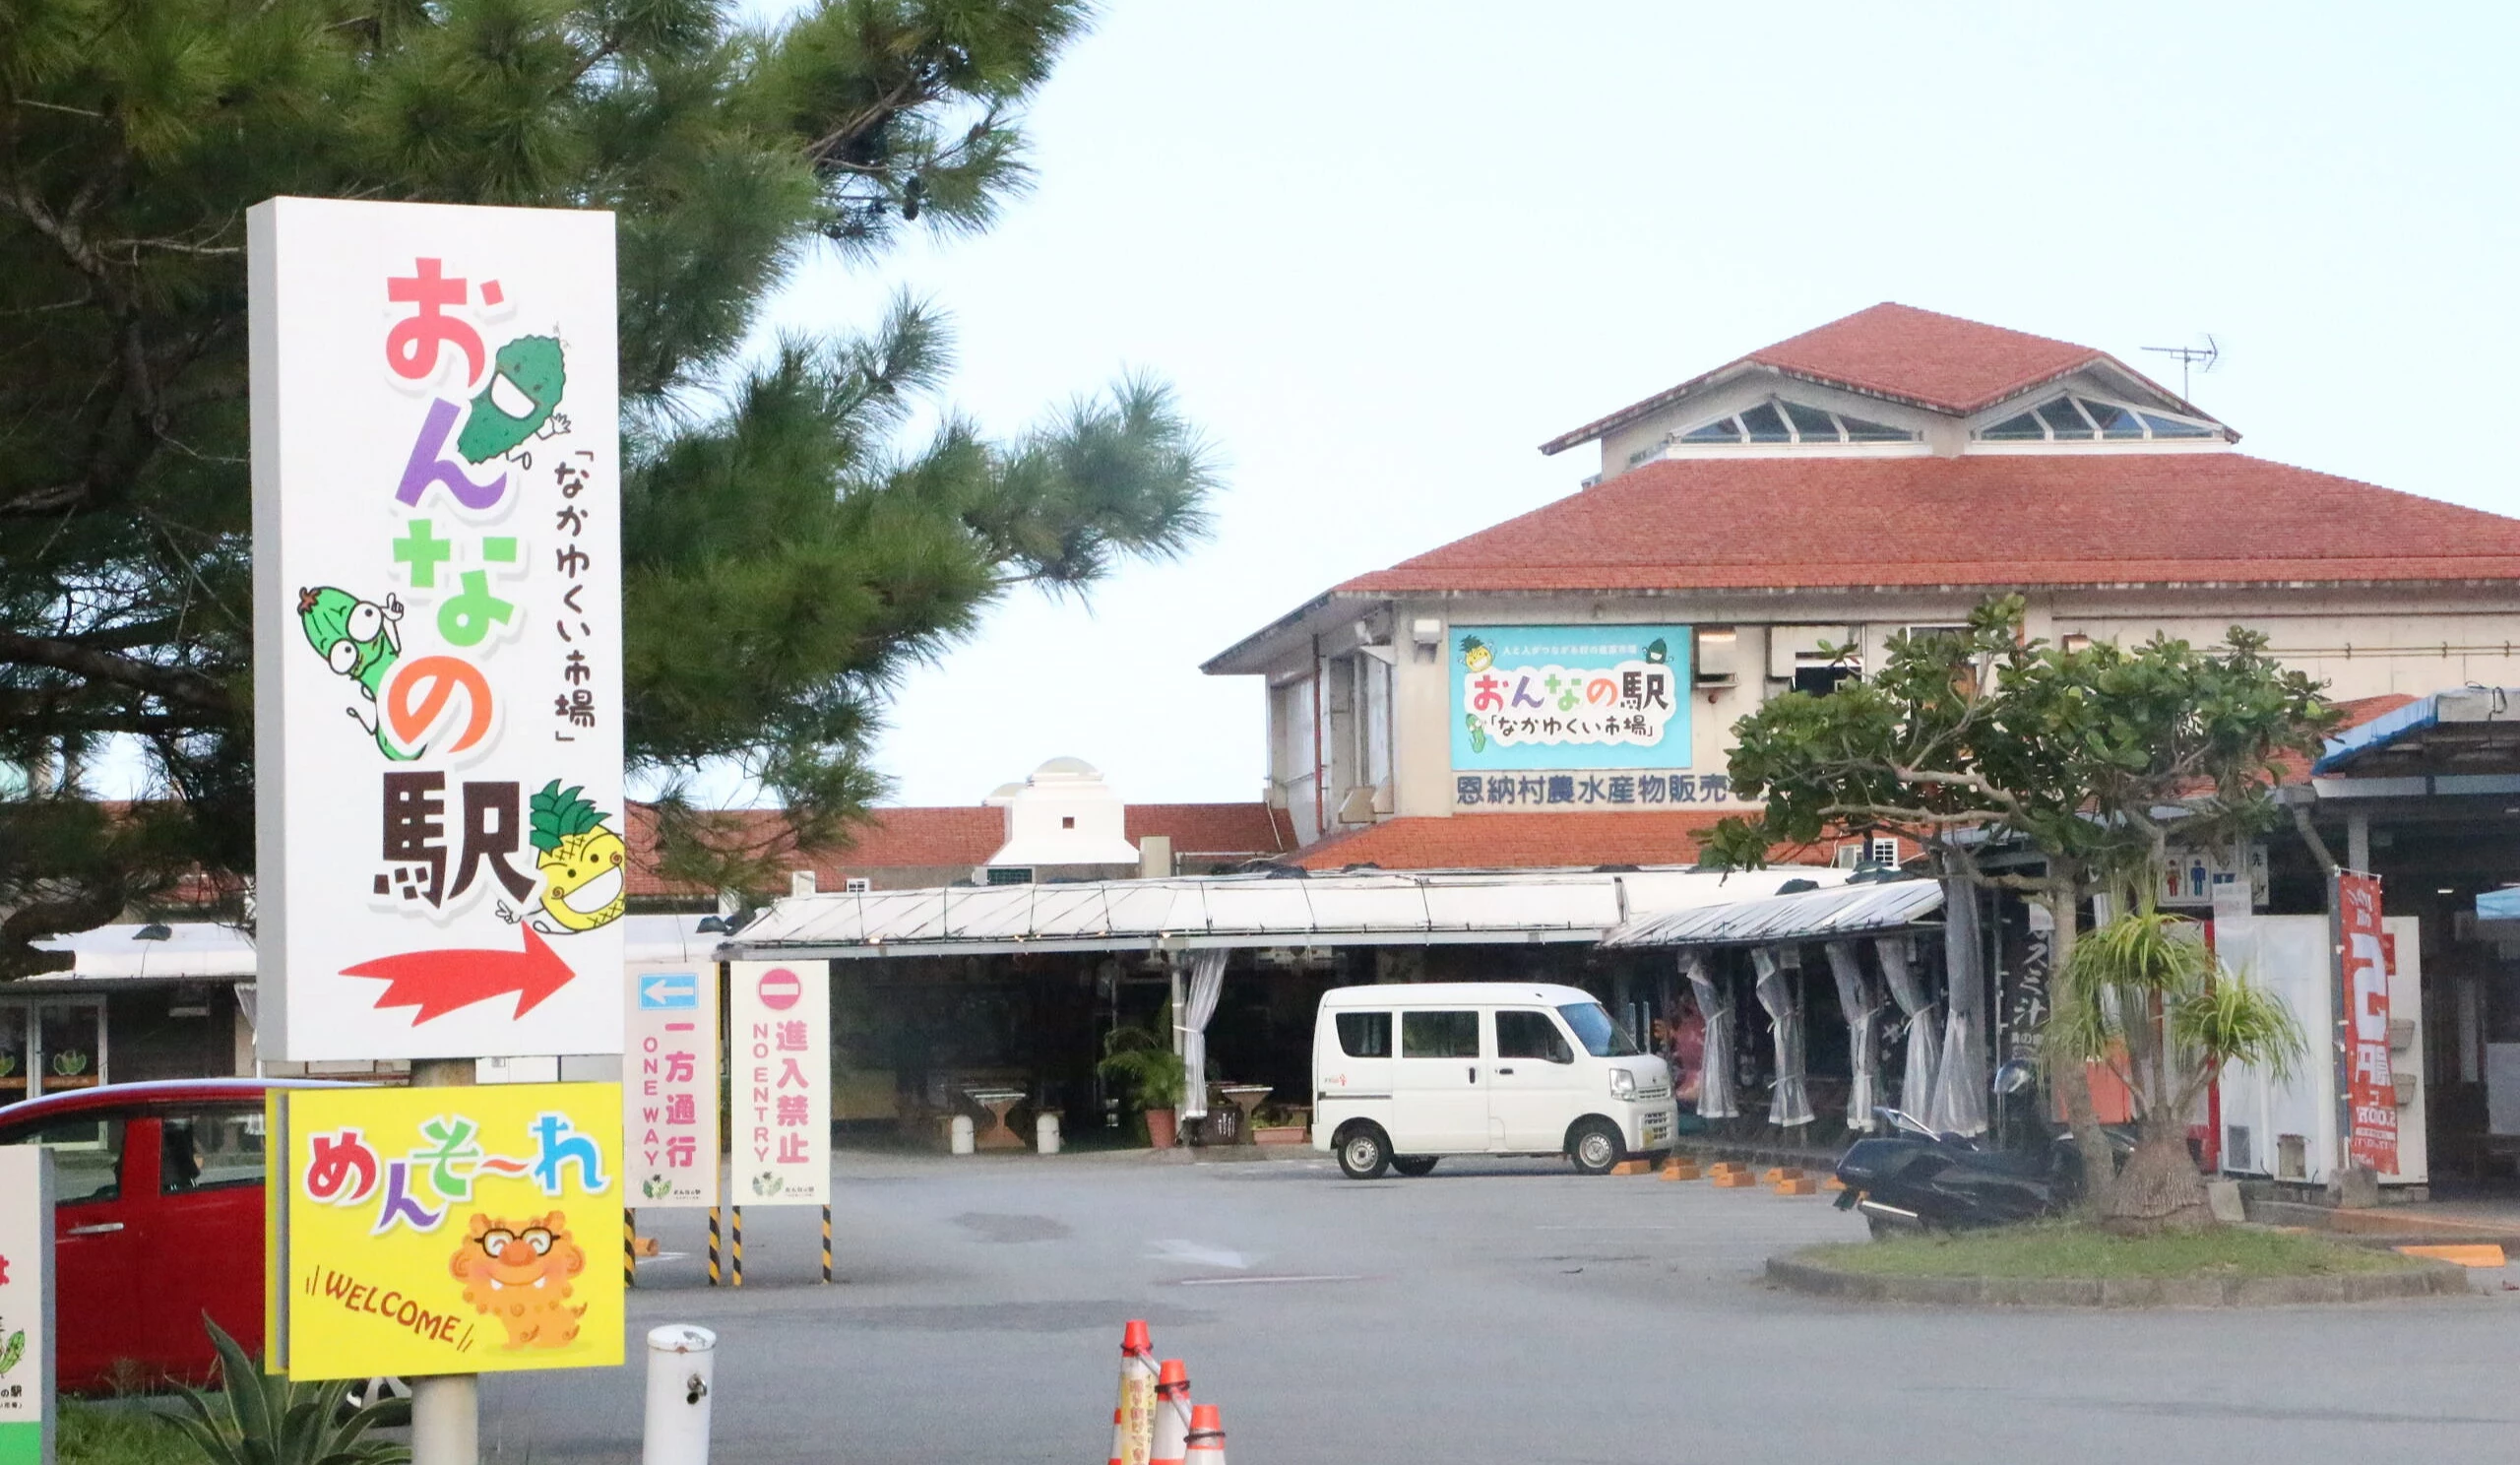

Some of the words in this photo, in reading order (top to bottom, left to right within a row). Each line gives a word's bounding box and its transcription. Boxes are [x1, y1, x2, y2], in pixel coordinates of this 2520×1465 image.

[374, 257, 536, 909] おんなの駅
[554, 450, 596, 742] 「なかゆくい市場」
[1474, 671, 1669, 712] おんなの駅
[1490, 715, 1654, 737] 「なかゆくい市場」
[1457, 773, 1768, 805] 恩納村農水産物販売
[643, 1037, 659, 1096] ONE
[753, 1023, 769, 1058] NO
[664, 1022, 697, 1168] 一方通行
[753, 1067, 770, 1162] ENTRY
[776, 1020, 809, 1164] 進入禁止
[643, 1107, 660, 1166] WAY
[325, 1270, 462, 1344] WELCOME
